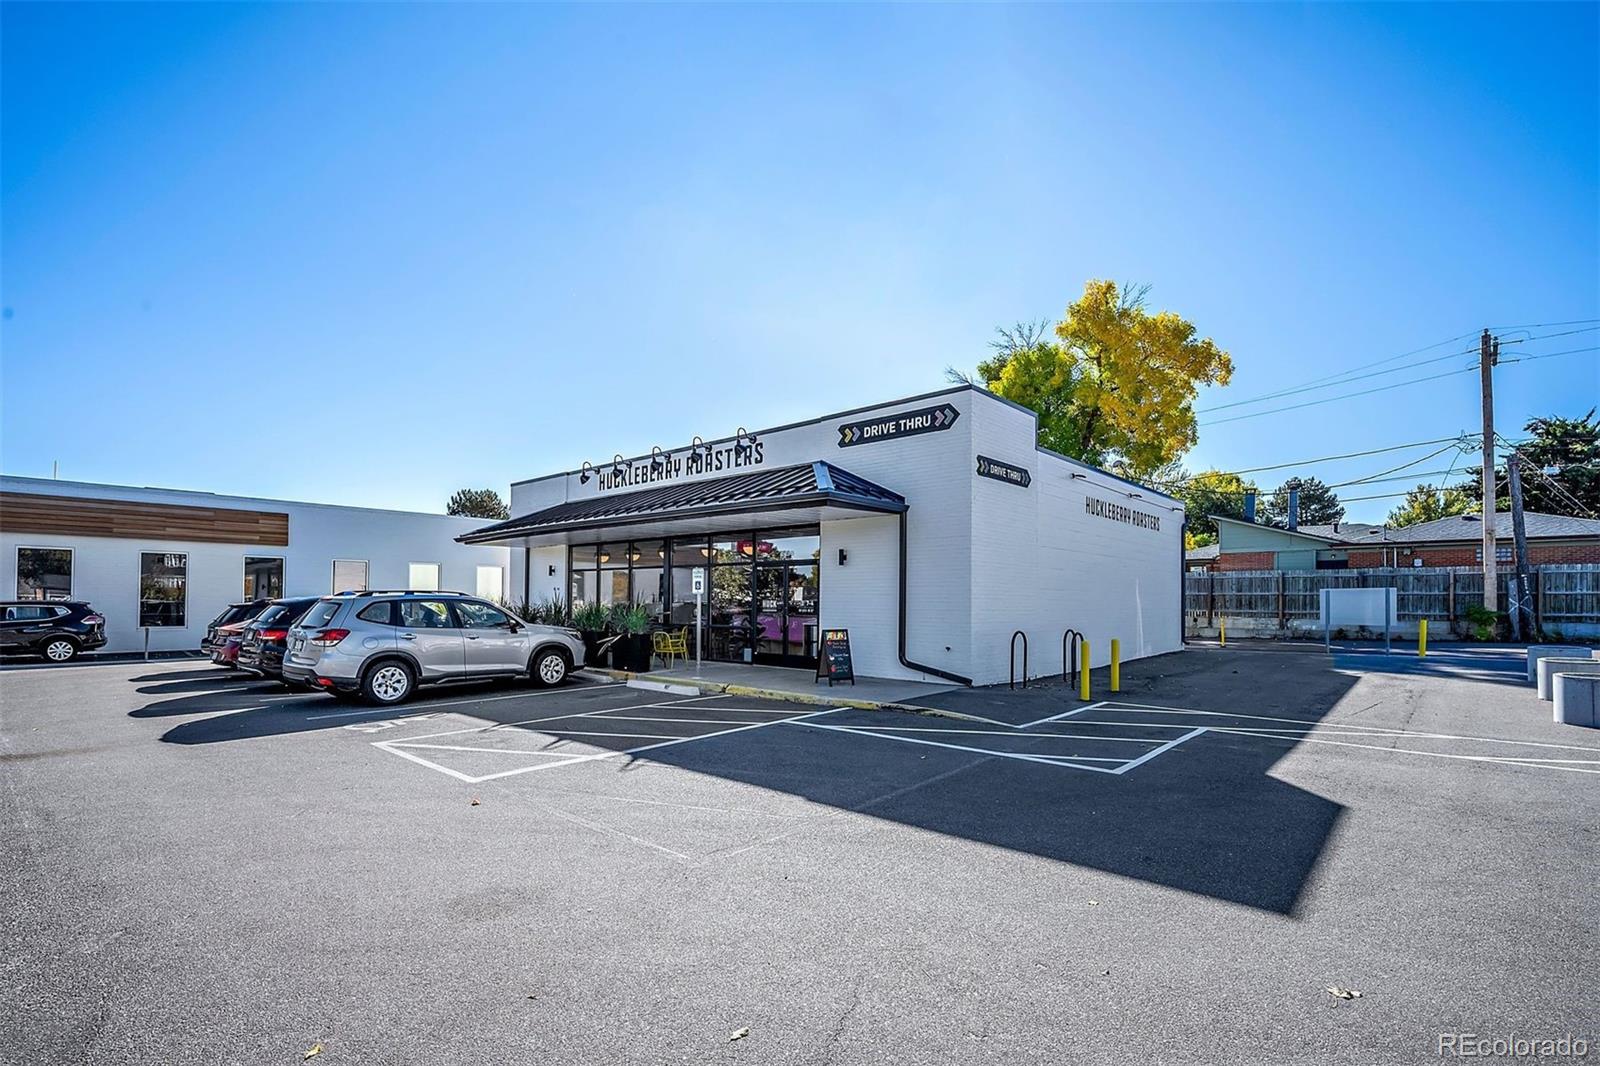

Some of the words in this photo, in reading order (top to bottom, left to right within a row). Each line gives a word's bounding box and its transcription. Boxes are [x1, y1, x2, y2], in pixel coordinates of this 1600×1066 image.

[863, 421, 897, 438] DRIVE
[898, 414, 932, 432] THRU
[685, 442, 764, 476] ROASTERS
[990, 464, 1007, 478] DRIVE
[1007, 469, 1021, 482] THRU
[1085, 495, 1131, 525] HUCKLEBERRY
[1132, 510, 1160, 532] ROASTERS
